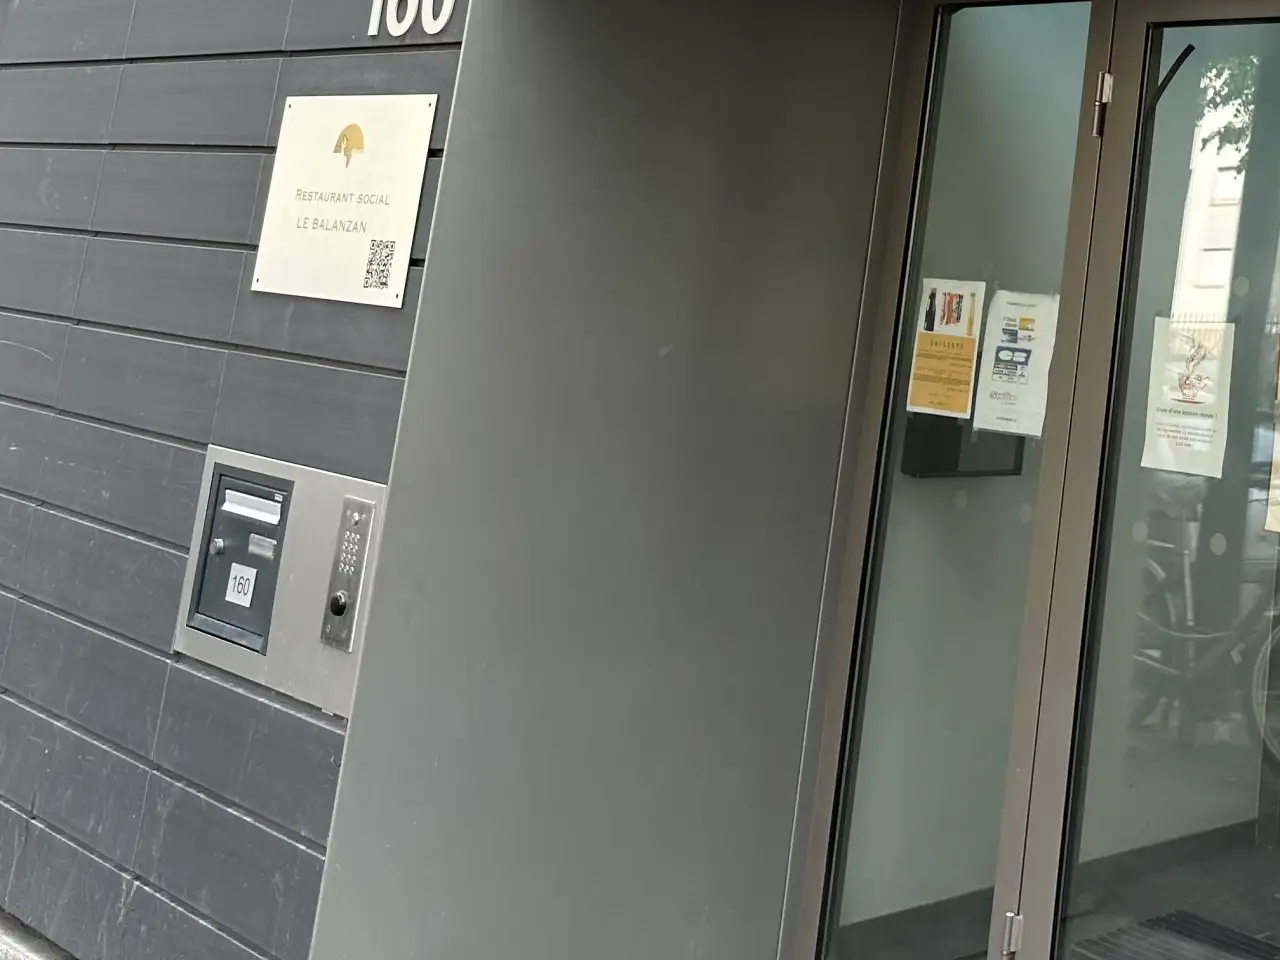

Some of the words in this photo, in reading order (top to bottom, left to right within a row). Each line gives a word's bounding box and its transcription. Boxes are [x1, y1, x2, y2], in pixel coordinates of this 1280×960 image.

[295, 189, 354, 204] RESTAURANT
[356, 193, 390, 206] SOCIAL
[296, 217, 309, 230] LE
[312, 218, 367, 234] BALANZAN
[232, 575, 250, 596] 160
